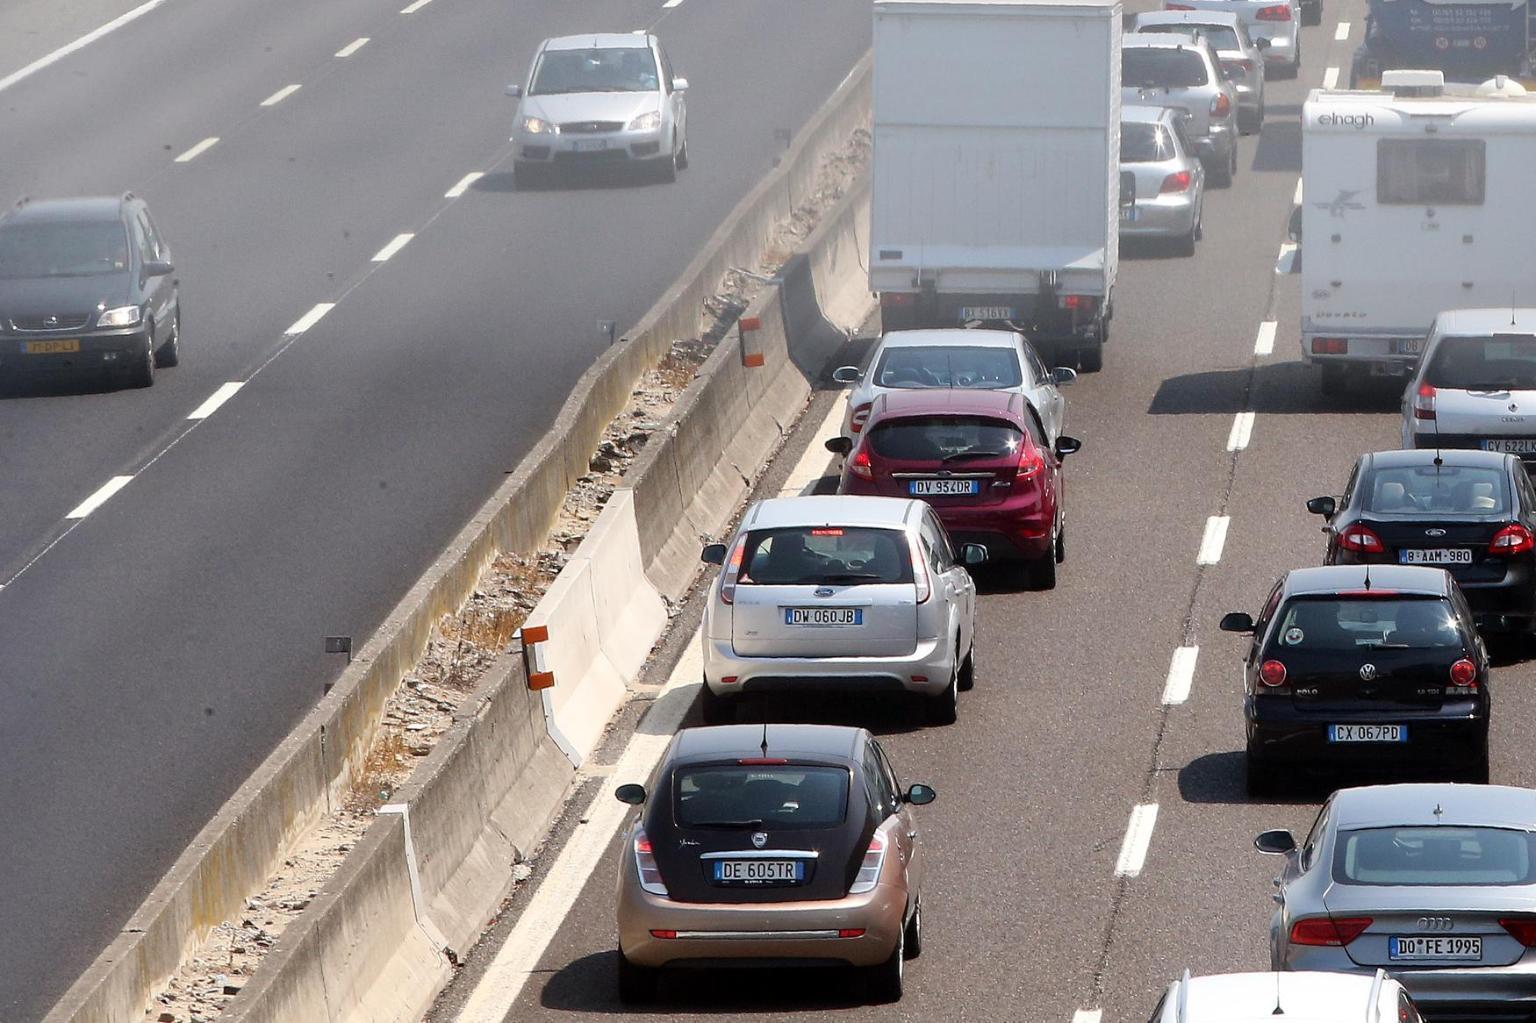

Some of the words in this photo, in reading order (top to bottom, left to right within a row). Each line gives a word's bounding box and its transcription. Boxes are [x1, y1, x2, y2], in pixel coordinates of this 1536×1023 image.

[1318, 113, 1374, 129] elnagh
[917, 481, 931, 493] DV
[794, 608, 808, 623] DW
[814, 608, 854, 624] 060JB
[1337, 727, 1352, 740] CX
[1358, 727, 1398, 740] 067PD
[723, 863, 742, 878] DE
[747, 863, 794, 878] 605TR
[1399, 939, 1415, 954] DO
[1426, 939, 1443, 954] FE
[1447, 939, 1480, 954] 1995
